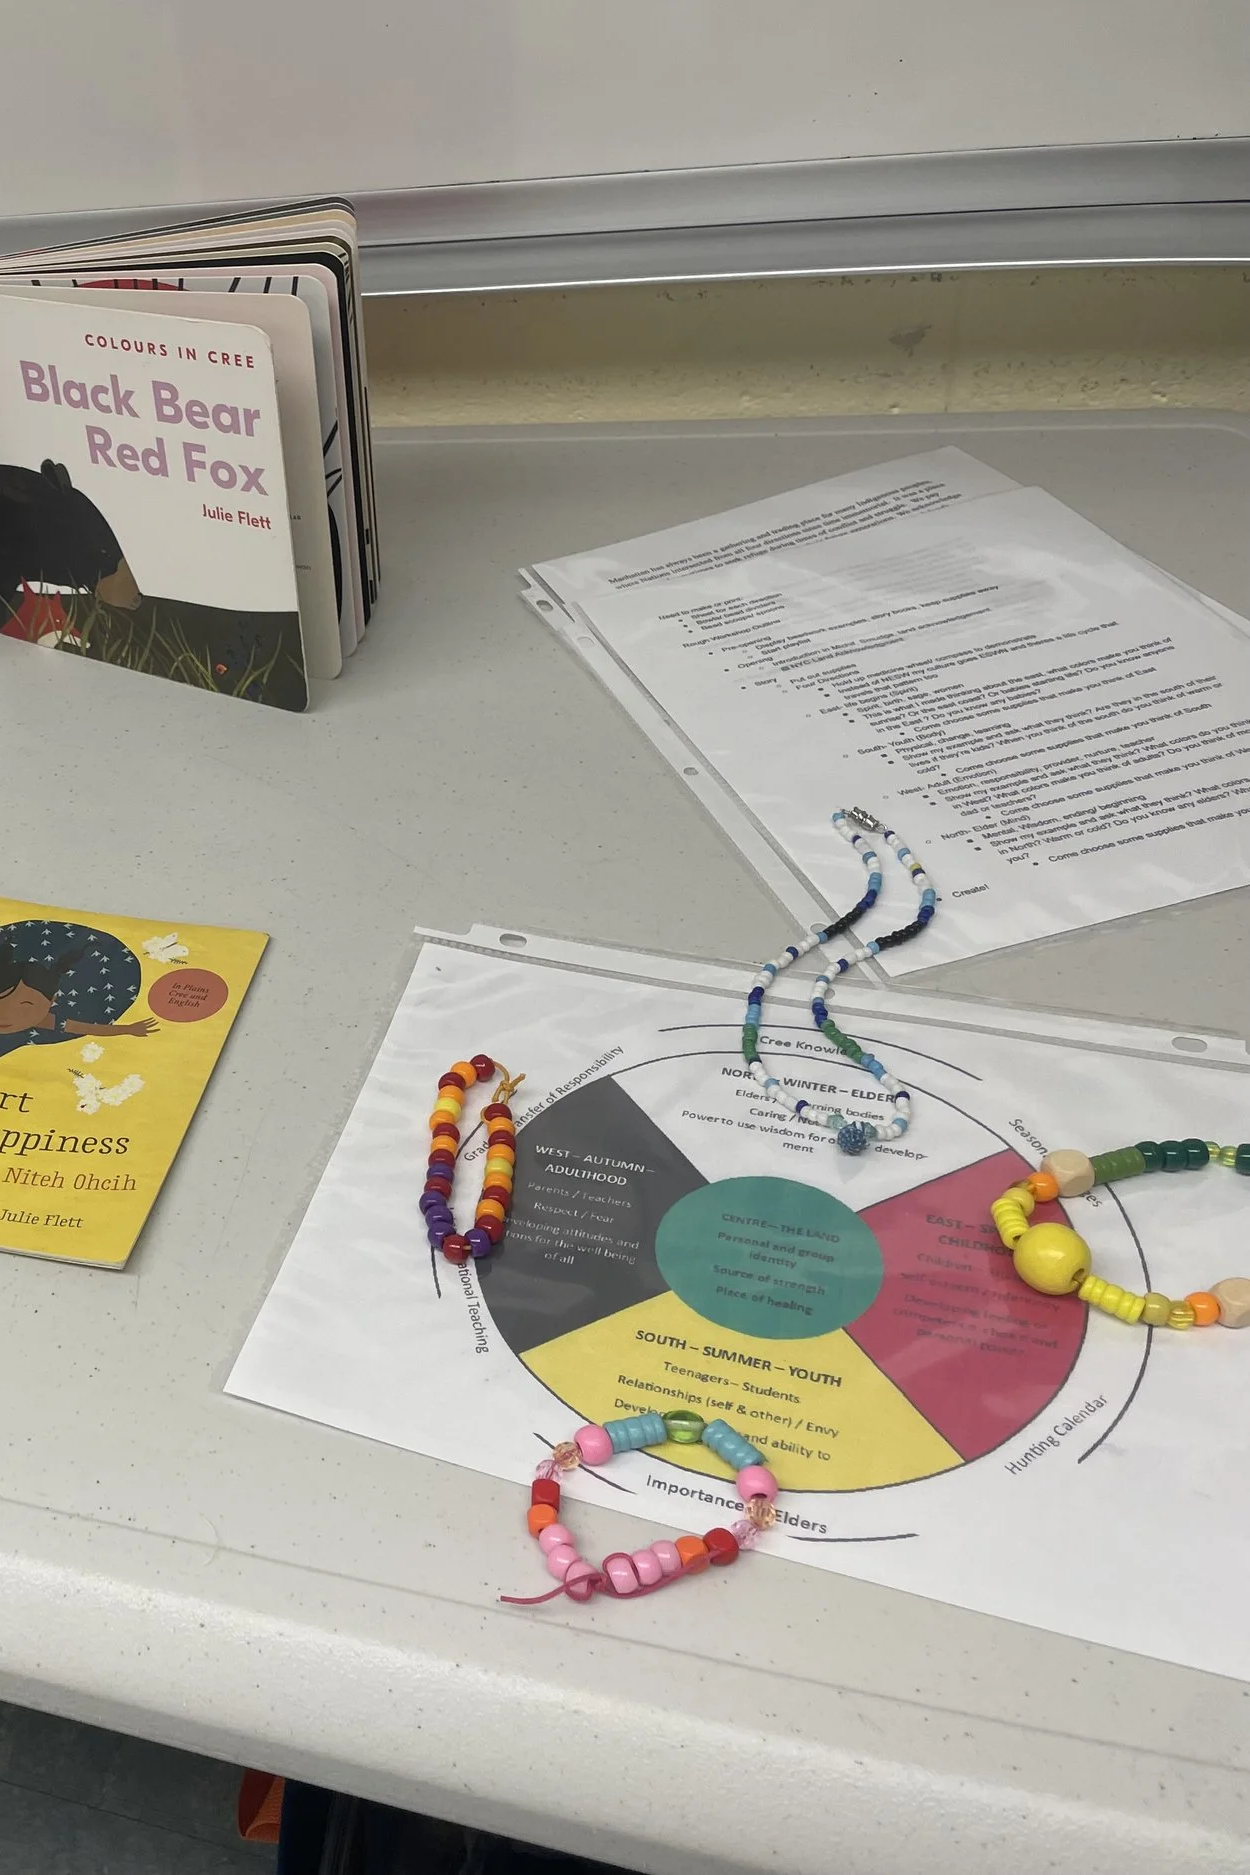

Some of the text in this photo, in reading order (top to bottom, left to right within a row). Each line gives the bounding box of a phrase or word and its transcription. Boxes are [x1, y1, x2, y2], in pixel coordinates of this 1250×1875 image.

[85, 334, 255, 369] COLOURS IN CREE
[20, 361, 261, 437] Black Bear
[86, 425, 269, 496] Red Fox
[202, 504, 271, 530] Julie Flett
[738, 656, 773, 669] Opening
[889, 737, 915, 748] Youth
[928, 780, 951, 789] Adult
[952, 769, 997, 784] (Emotion)
[972, 822, 998, 832] Elder
[1000, 815, 1030, 826] (Mind)
[1049, 812, 1234, 862] Come choose some supplies that make
[1006, 853, 1029, 864] you?
[952, 884, 989, 898] Create!
[183, 984, 209, 993] Plains
[169, 998, 200, 1007] English
[760, 1036, 847, 1055] Cree Knowle
[722, 1068, 896, 1103] NOR WINTER ELDER
[464, 1046, 624, 1161] Grad ansfer of Responsibility
[750, 1108, 787, 1122] Caring
[846, 1108, 884, 1120] bodies
[682, 1110, 719, 1123] Power
[721, 1117, 733, 1125] to
[738, 1121, 756, 1130] use
[760, 1125, 805, 1139] wisdom
[809, 1132, 826, 1143] for
[783, 1141, 814, 1153] ment
[1009, 1119, 1048, 1158] Season
[536, 1145, 645, 1173] WEST AUTUMN
[2, 1167, 65, 1189] Niteh
[73, 1173, 137, 1192] Ohcih
[545, 1164, 627, 1185] ADULTHOOD
[44, 1213, 84, 1229] Flett
[717, 1232, 834, 1263] Personal and group
[807, 1229, 840, 1243] LAND
[713, 1265, 824, 1295] Source of strength
[752, 1294, 764, 1302] of
[767, 1296, 813, 1316] healing
[468, 1301, 488, 1353] Teaching
[636, 1329, 842, 1387] SOUTH SUMMER YOUTH
[742, 1382, 800, 1404] Students
[618, 1375, 839, 1438] Relationships (self & other) Envy
[1005, 1394, 1108, 1475] Hunting Calendar
[771, 1439, 813, 1460] ability
[818, 1451, 830, 1461] to
[647, 1475, 827, 1534] Importance Elders
